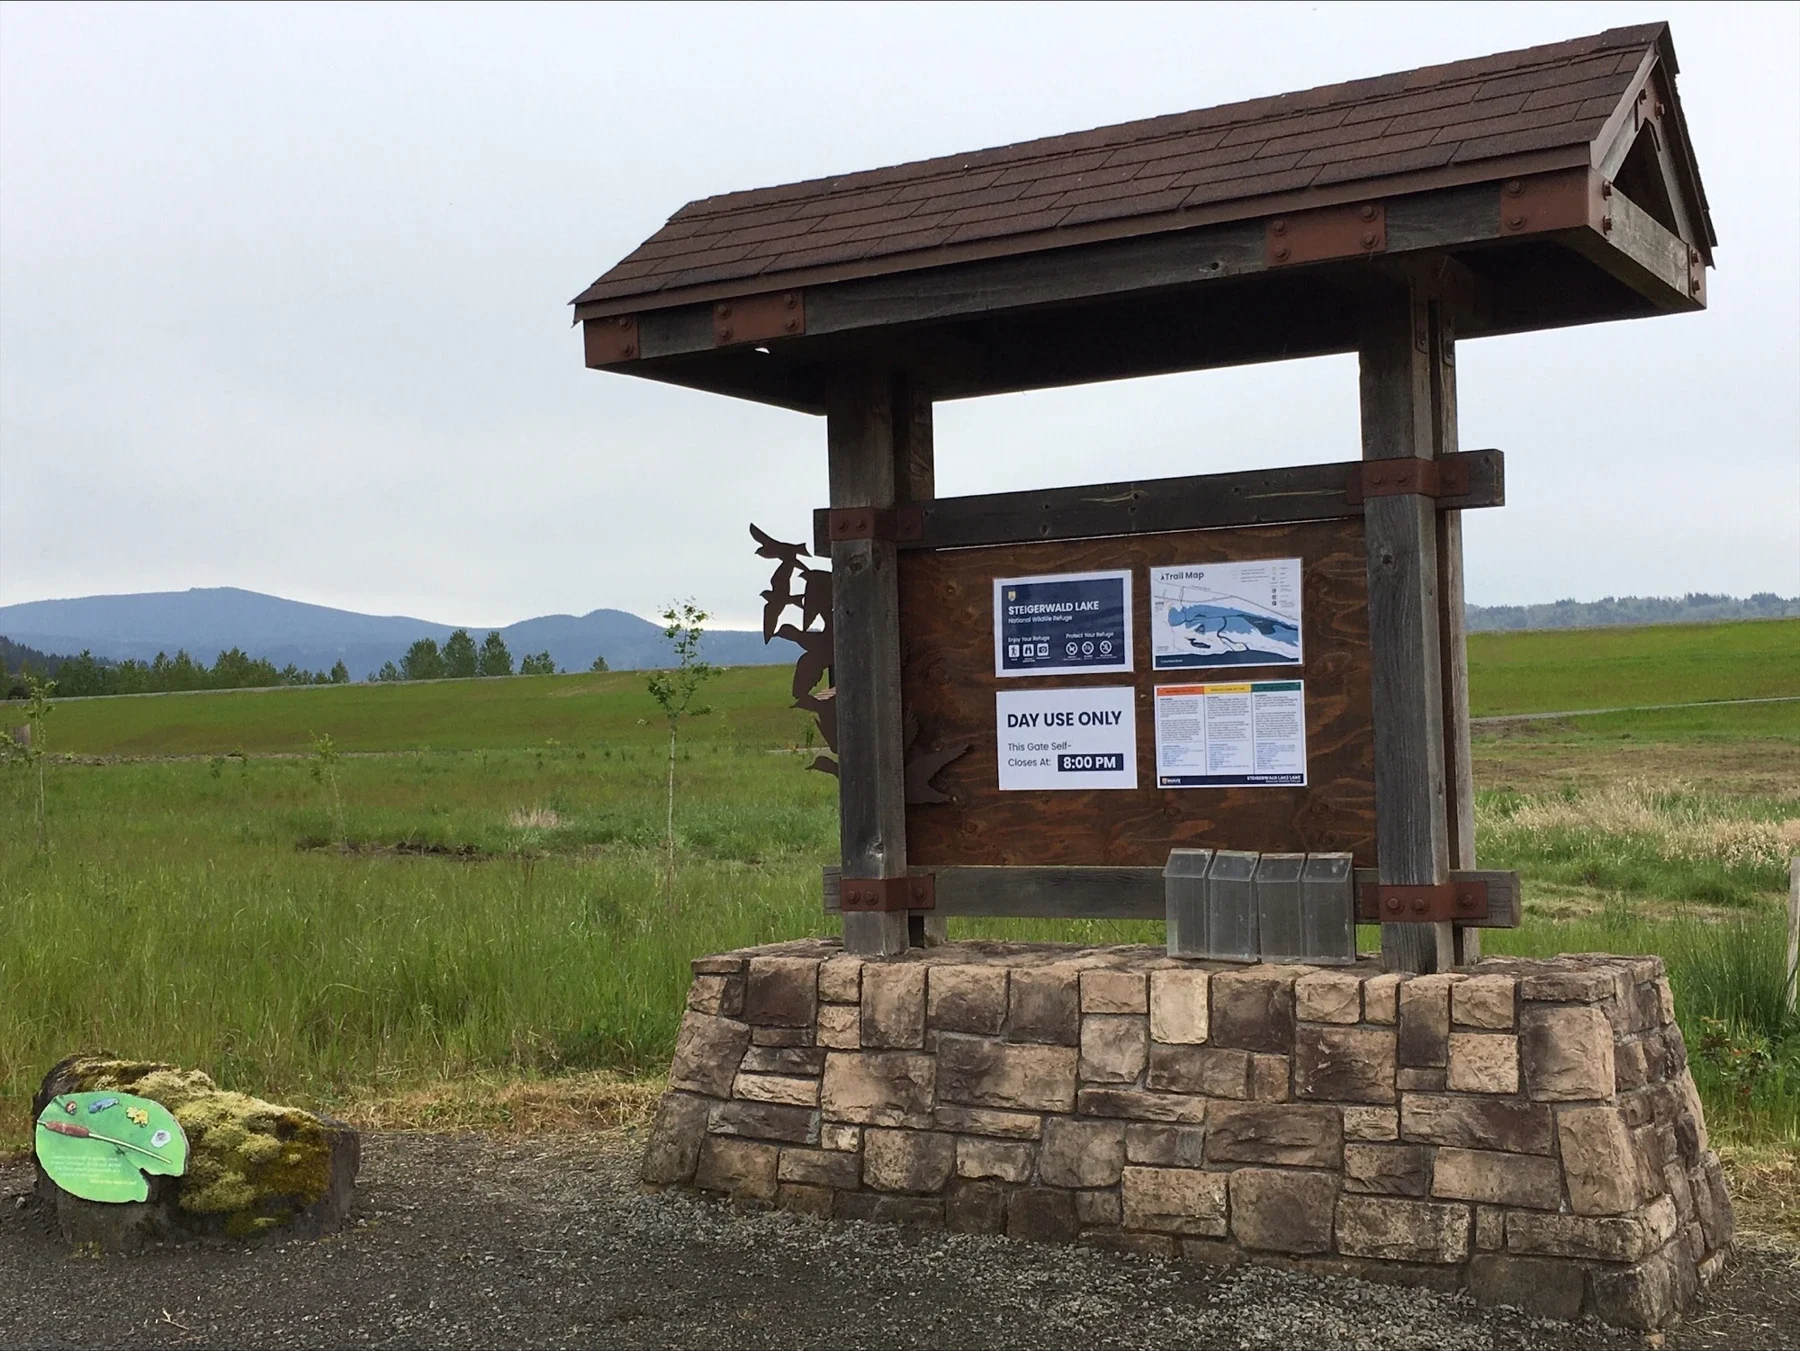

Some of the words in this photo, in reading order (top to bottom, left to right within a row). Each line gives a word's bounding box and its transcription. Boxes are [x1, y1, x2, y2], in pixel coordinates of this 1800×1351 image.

[1165, 573, 1184, 581] Trail
[1185, 571, 1205, 582] Map
[1008, 602, 1074, 615] STEIGERWALD
[1075, 601, 1100, 611] LAKE
[1007, 713, 1040, 728] DAY
[1044, 712, 1075, 727] USE
[1078, 711, 1122, 726] ONLY
[1008, 743, 1025, 751] This
[1027, 742, 1049, 751] Gate
[1051, 742, 1072, 750] Self-
[1008, 758, 1038, 767] Closes
[1040, 757, 1052, 766] At:
[1063, 756, 1093, 769] 8:00
[1095, 756, 1116, 768] PM
